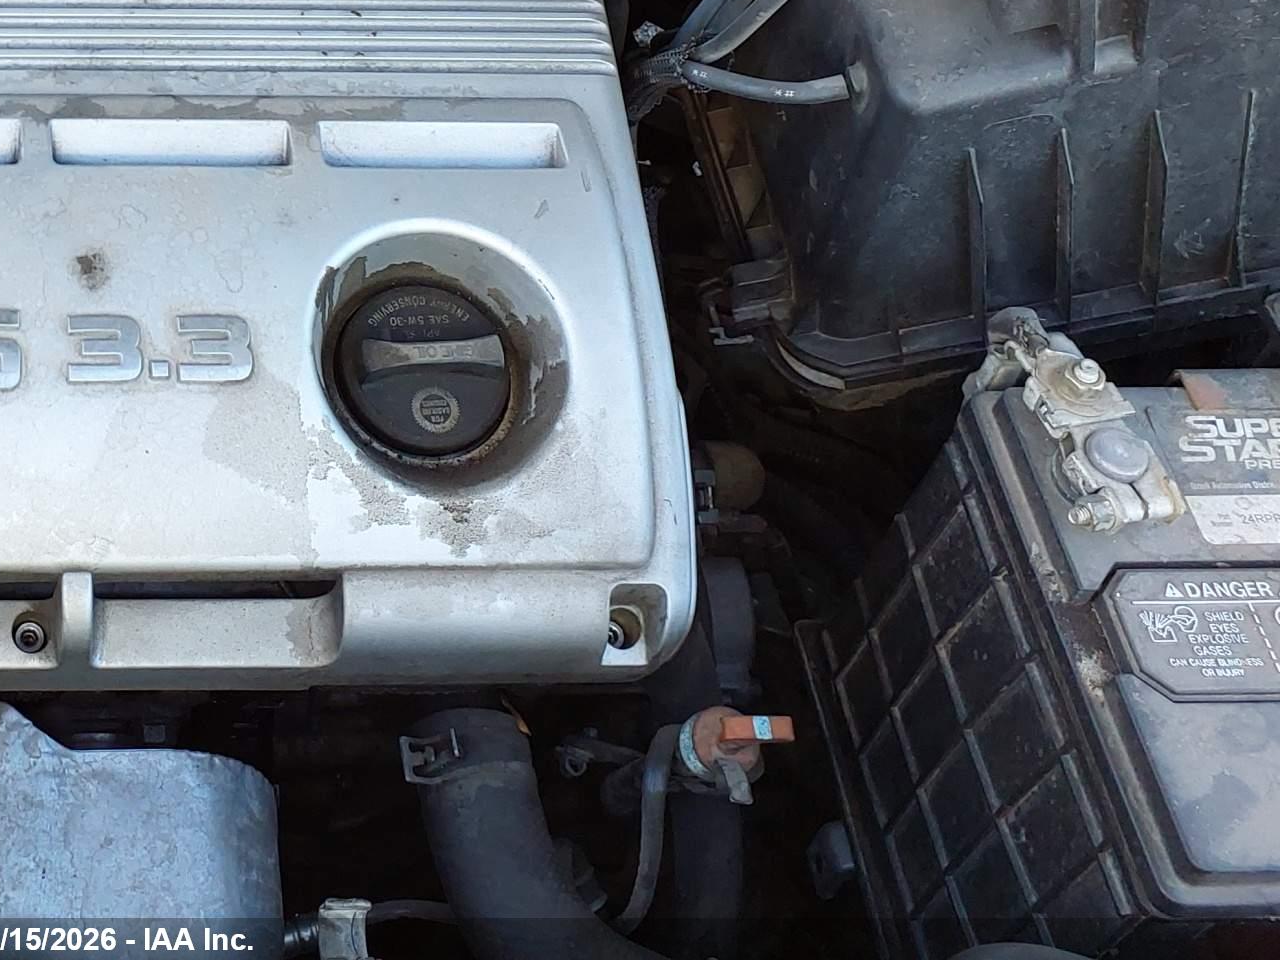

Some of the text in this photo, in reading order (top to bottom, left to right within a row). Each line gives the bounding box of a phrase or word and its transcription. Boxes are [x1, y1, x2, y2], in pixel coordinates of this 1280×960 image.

[367, 295, 426, 327] CONSERVING
[389, 314, 449, 328] SAE 5W-30
[66, 313, 255, 383] 3.3
[1184, 581, 1274, 598] DANGER
[1204, 611, 1244, 622] SHIELD
[1209, 623, 1240, 634] EYES
[1188, 634, 1249, 644] EXPLOSIVE
[1193, 645, 1233, 656] GASES
[1169, 658, 1189, 667] CAN
[1189, 657, 1217, 668] CAUSE
[1202, 668, 1216, 678] OR
